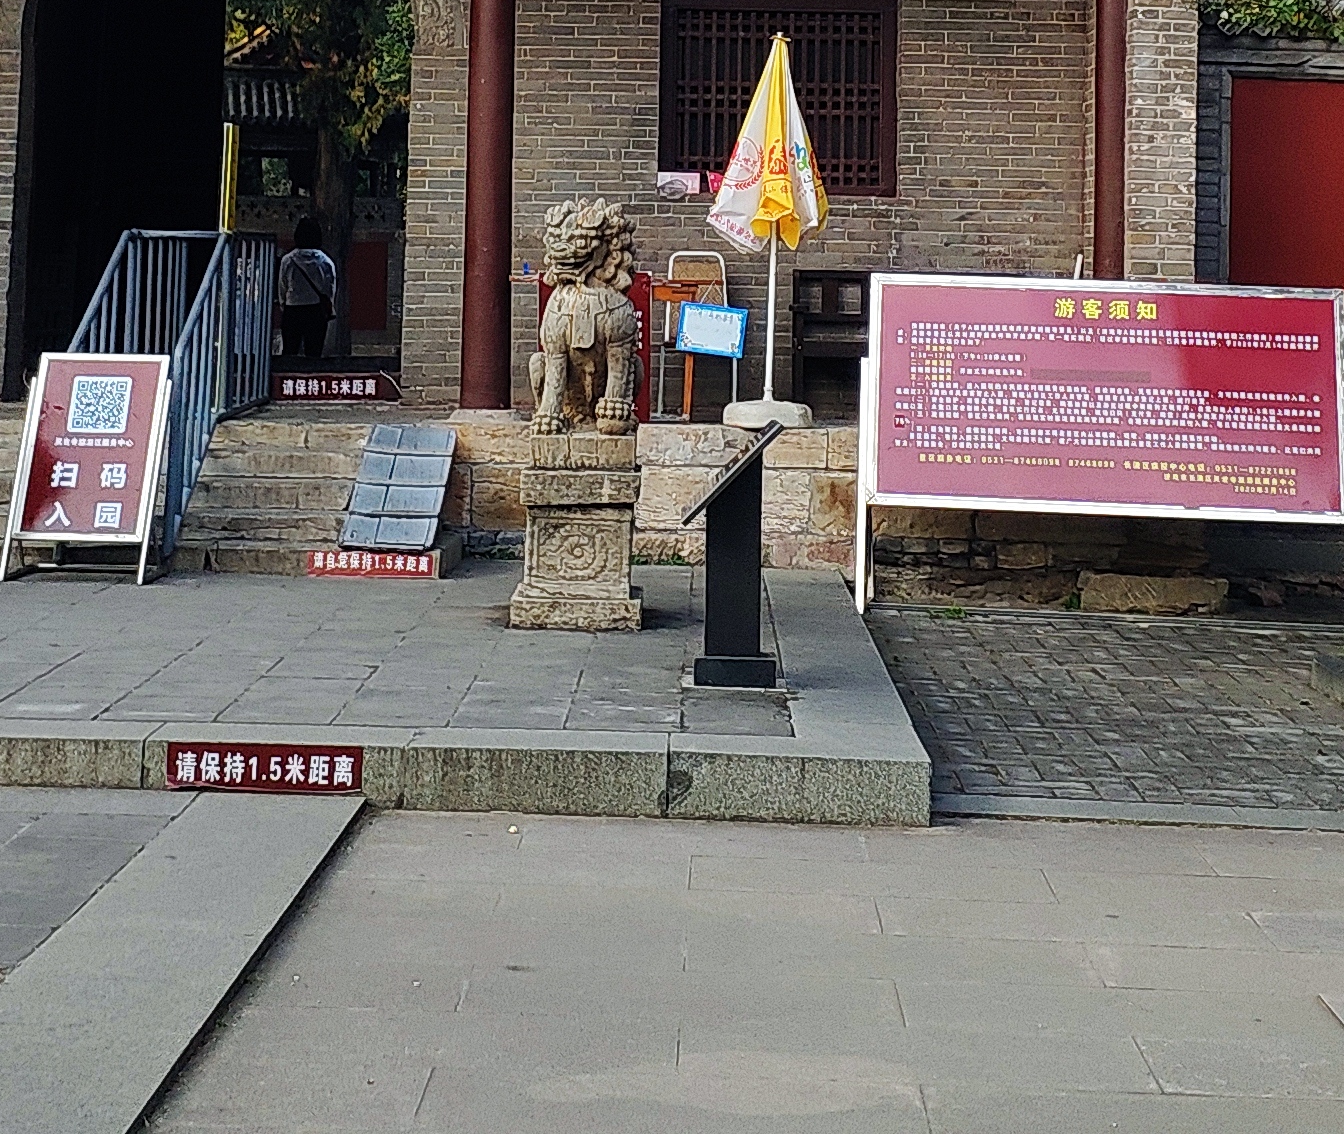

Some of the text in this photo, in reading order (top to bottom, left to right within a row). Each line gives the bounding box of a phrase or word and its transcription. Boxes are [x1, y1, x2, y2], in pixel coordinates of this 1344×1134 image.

[1054, 297, 1158, 320] 游客须知
[282, 379, 376, 396] 请保持1.5米距离
[50, 460, 128, 489] 扫码
[44, 500, 123, 528] 入园
[175, 750, 355, 786] 请保持1.5米距离
